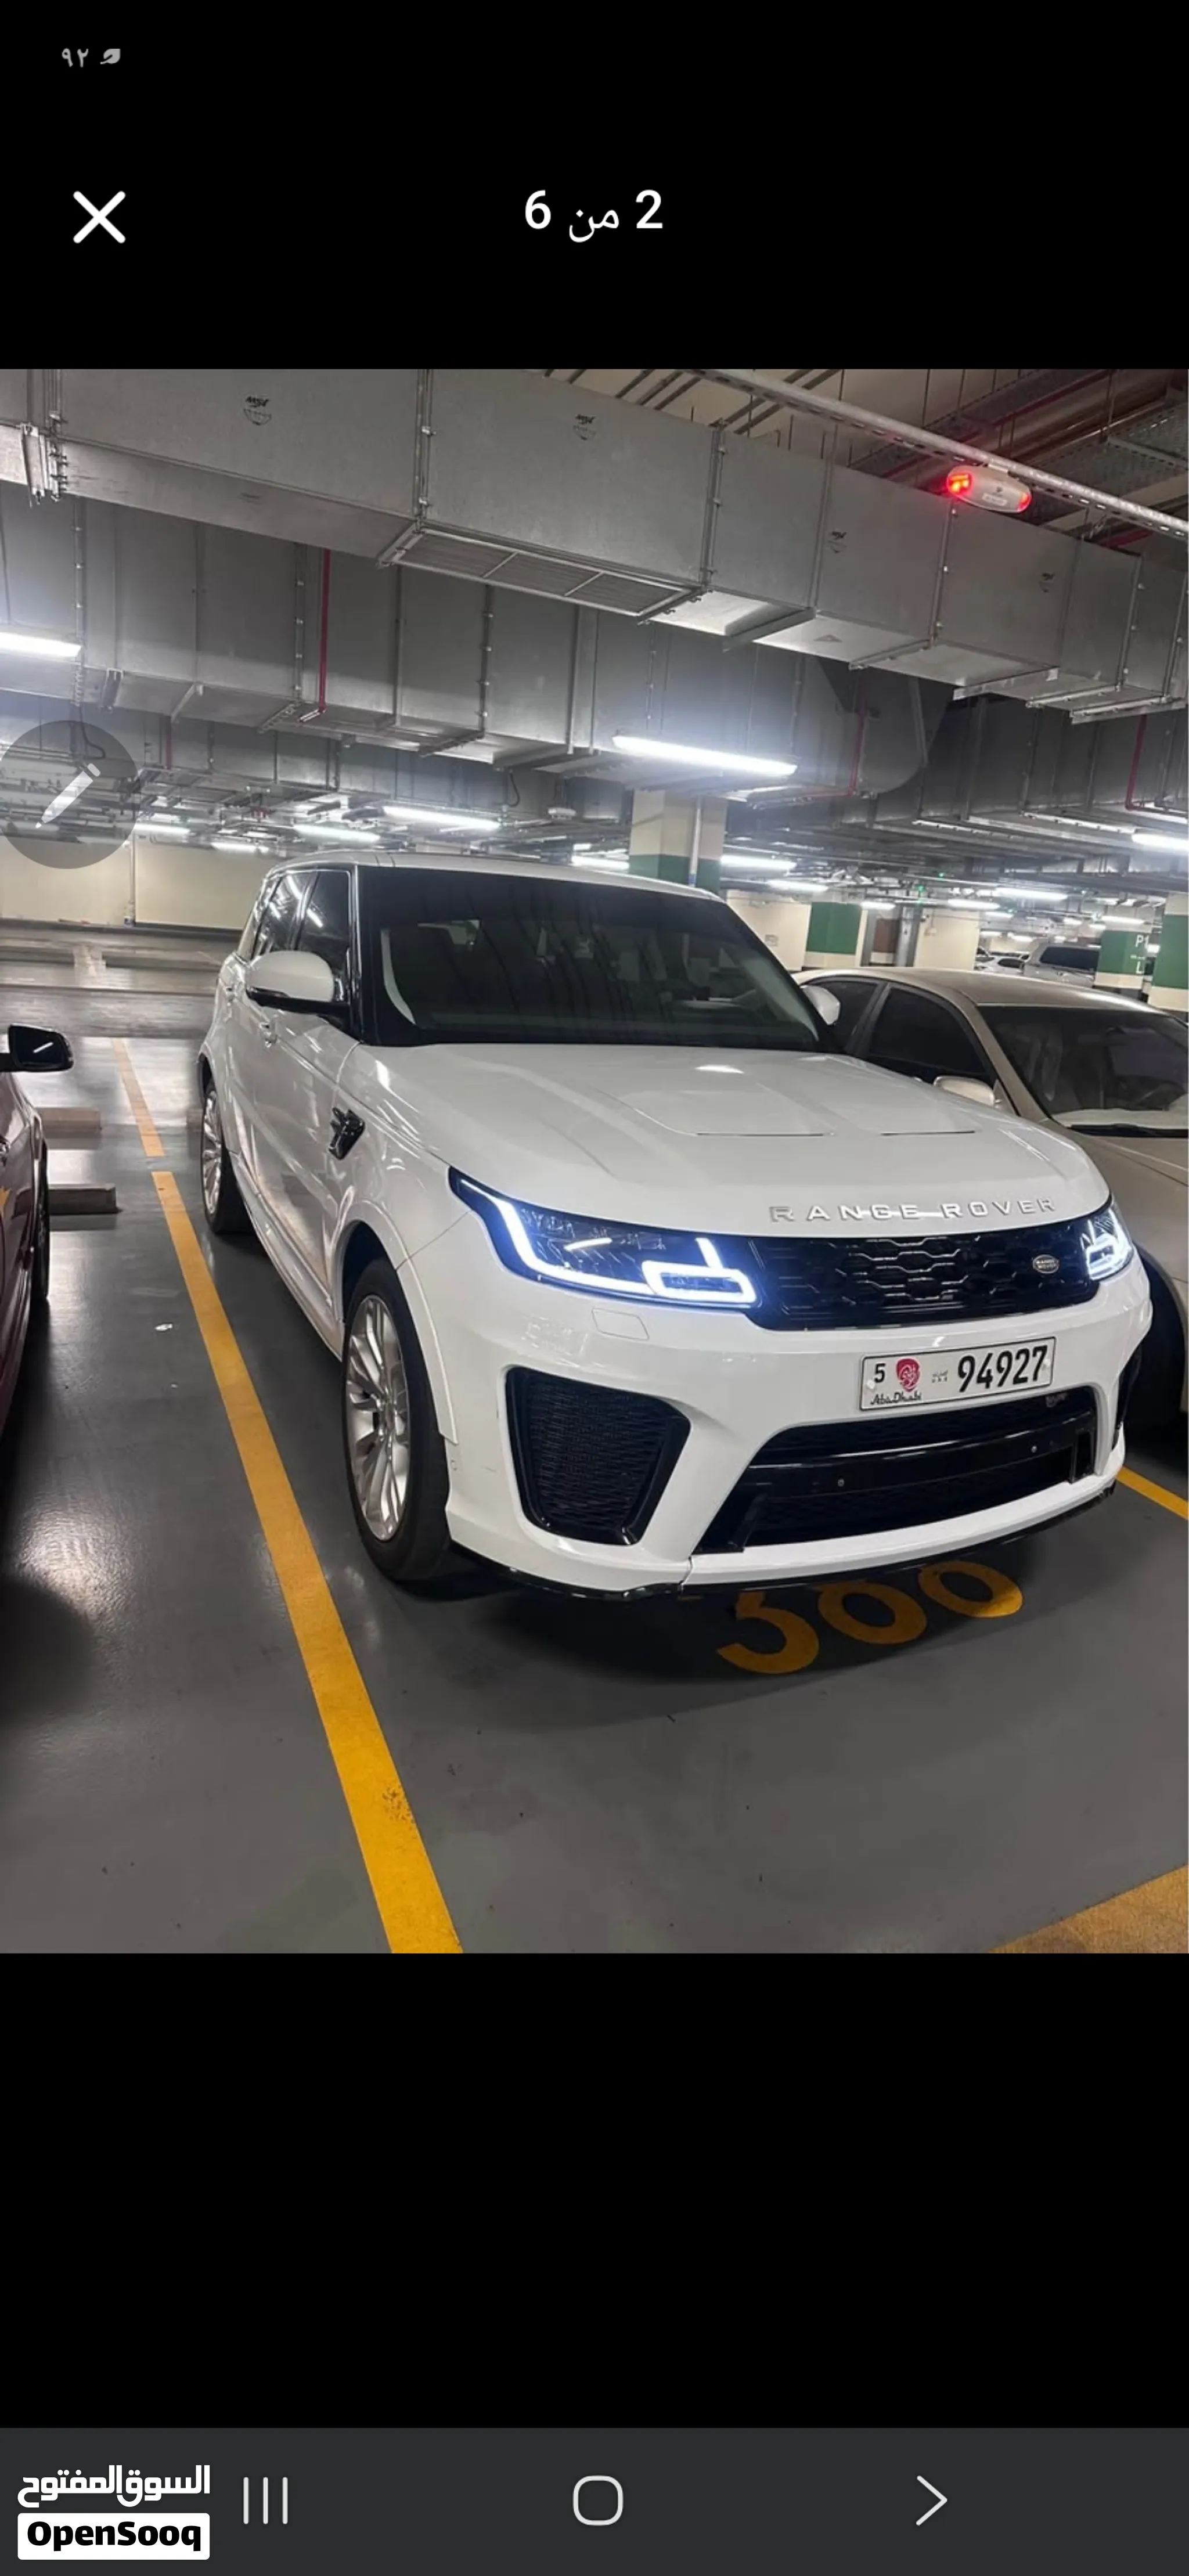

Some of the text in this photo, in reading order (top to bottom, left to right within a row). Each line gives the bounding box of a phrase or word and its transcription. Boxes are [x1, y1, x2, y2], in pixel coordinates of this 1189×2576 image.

[769, 1199, 1055, 1222] RANGE ROVER
[874, 1363, 887, 1384] 5
[959, 1345, 1047, 1393] 94927
